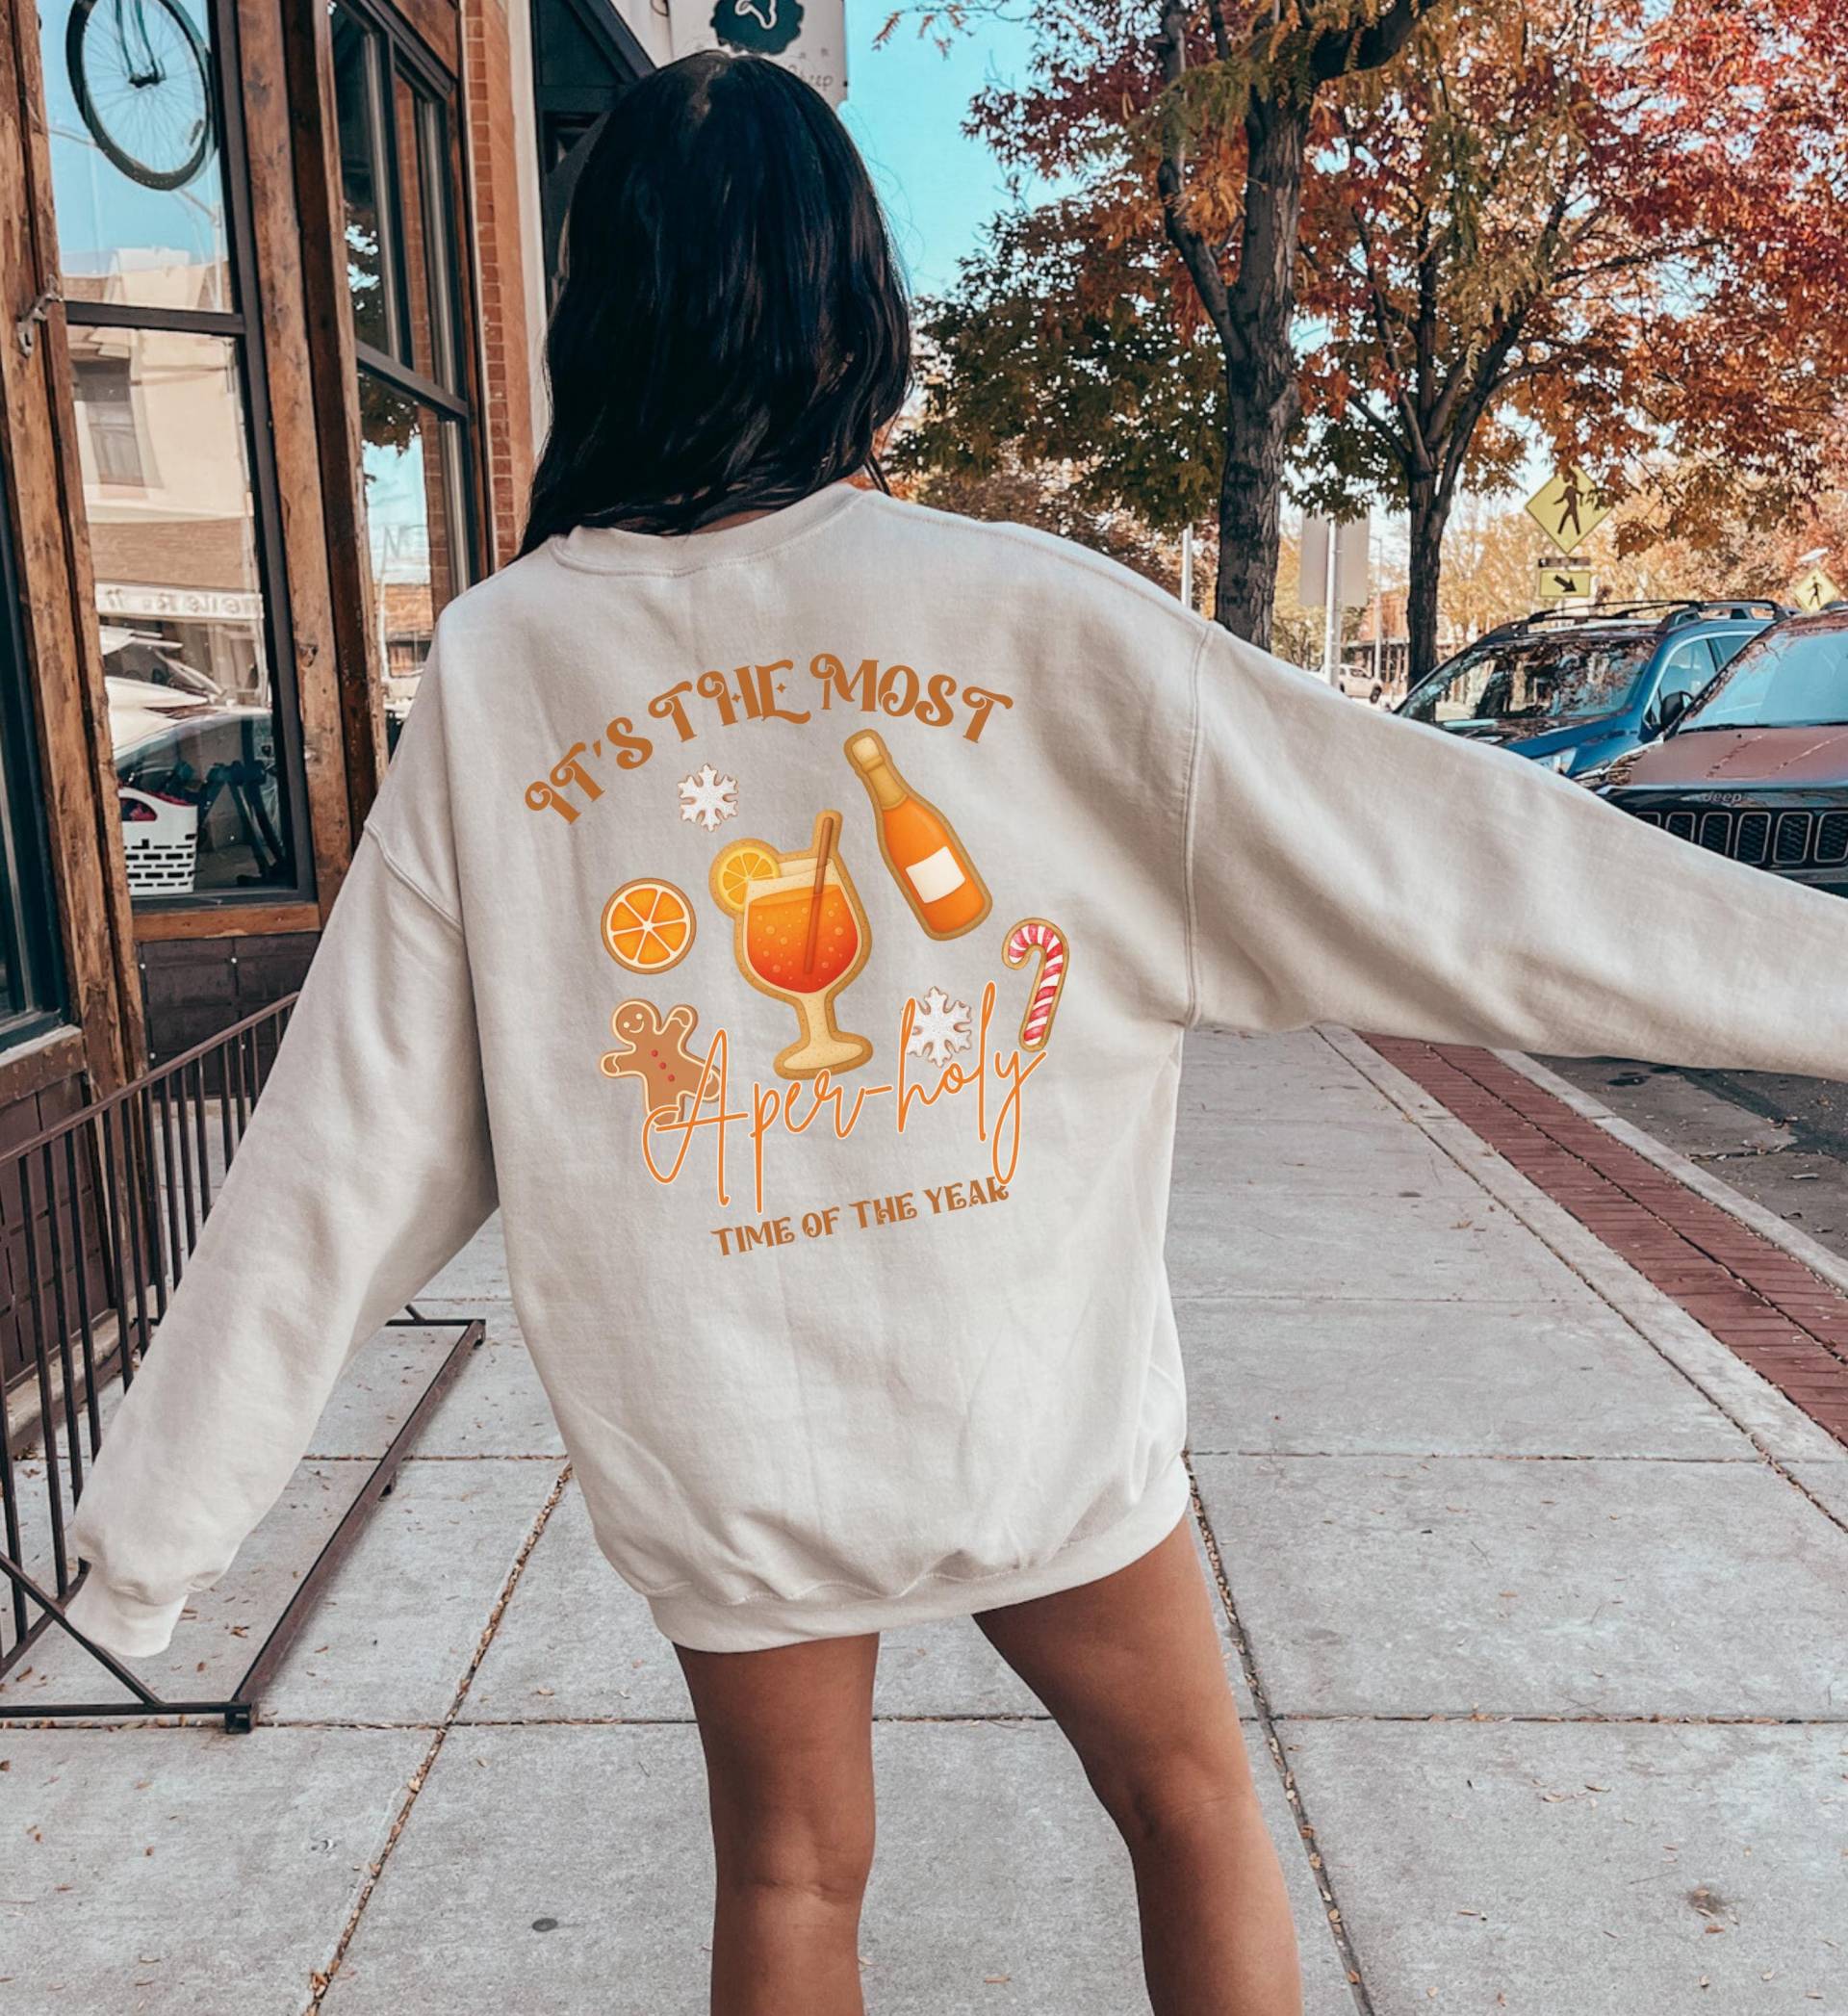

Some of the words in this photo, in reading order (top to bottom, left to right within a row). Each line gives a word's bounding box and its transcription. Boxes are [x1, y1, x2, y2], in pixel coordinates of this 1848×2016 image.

[525, 716, 654, 825] IT'S
[648, 659, 811, 742] THE
[809, 653, 1014, 744] MOST
[1702, 790, 1742, 803] Jeep
[642, 980, 1047, 1213] Aper-holy
[710, 1216, 795, 1255] TIME
[802, 1206, 840, 1238] OF
[849, 1192, 917, 1228] THE
[923, 1175, 1010, 1214] YEAR
